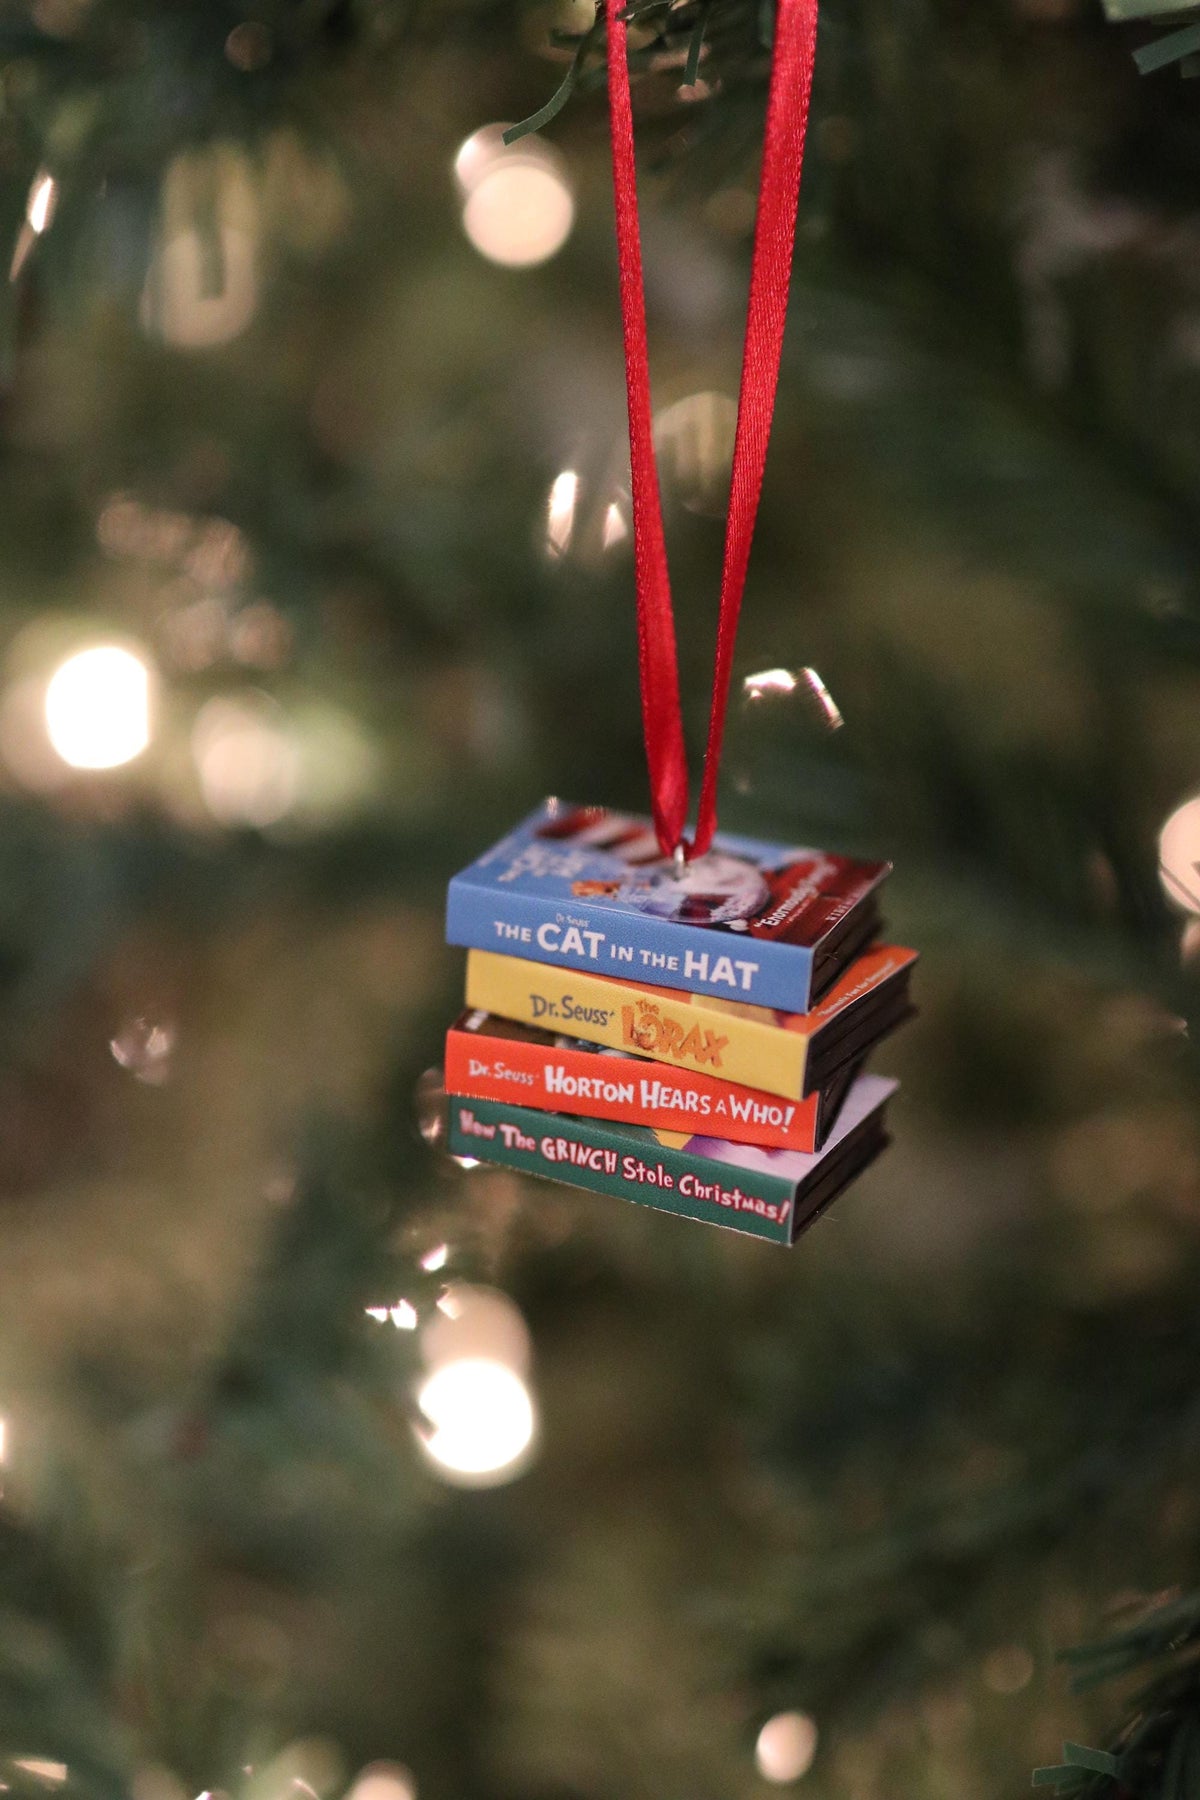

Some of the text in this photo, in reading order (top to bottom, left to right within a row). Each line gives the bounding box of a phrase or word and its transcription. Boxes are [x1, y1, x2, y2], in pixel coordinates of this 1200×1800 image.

[494, 921, 759, 991] THE CAT IN THE HAT
[529, 994, 559, 1018] Dr.
[621, 1005, 730, 1068] LORAX
[468, 1059, 491, 1076] Dr.
[544, 1064, 634, 1103] HORTON
[640, 1079, 712, 1116] HEARS
[715, 1099, 727, 1116] A
[729, 1094, 796, 1134] WHO!
[458, 1108, 496, 1140] How
[498, 1123, 537, 1152] The
[540, 1136, 618, 1175] GRINCH
[621, 1155, 675, 1189] Stole
